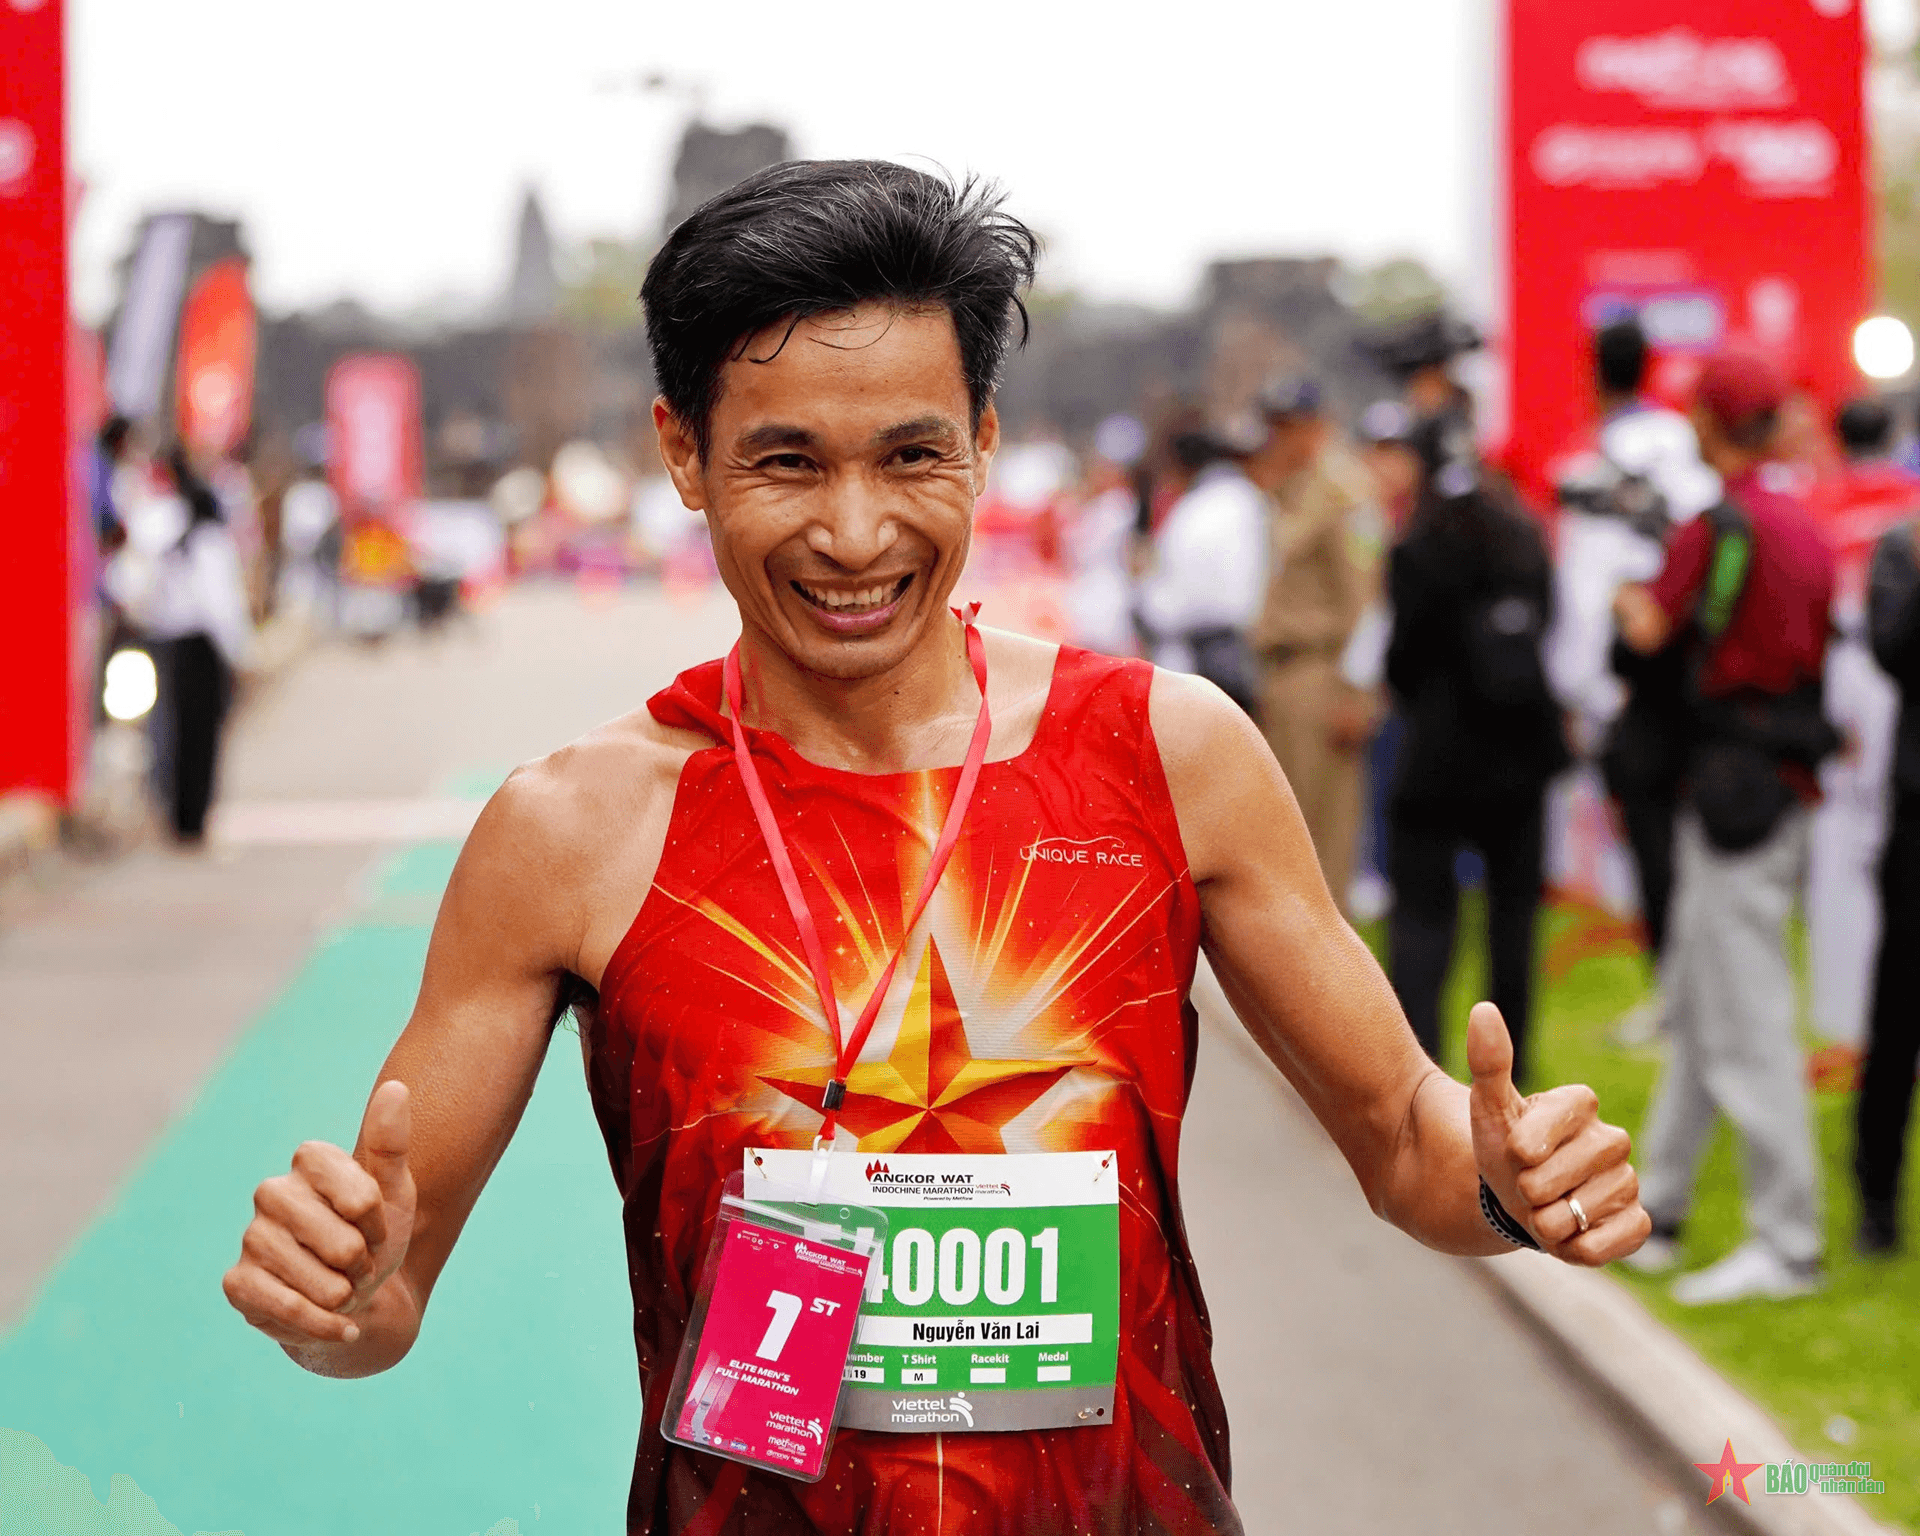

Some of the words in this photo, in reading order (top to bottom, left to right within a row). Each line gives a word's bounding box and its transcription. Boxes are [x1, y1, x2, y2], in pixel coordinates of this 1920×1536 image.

[1020, 847, 1089, 864] UNIQUE
[1096, 851, 1143, 867] RACE
[873, 1173, 935, 1184] ANGKOR
[941, 1174, 974, 1184] WAT
[872, 1185, 921, 1194] INDOCHINE
[922, 1186, 974, 1195] MARATHON
[912, 1319, 975, 1343] Nguyễn
[980, 1321, 1011, 1340] Văn
[1016, 1321, 1040, 1339] Lai
[911, 1353, 937, 1365] Shirt
[970, 1353, 1010, 1364] Racekit
[1038, 1350, 1069, 1362] Medal
[728, 1358, 758, 1373] ELITE
[757, 1366, 791, 1383] MEN'S
[914, 1372, 924, 1382] M
[714, 1366, 740, 1381] FULL
[740, 1373, 800, 1396] MARATHON
[891, 1398, 947, 1411] viettel
[769, 1410, 806, 1428] viettel
[891, 1411, 960, 1424] marathon
[765, 1419, 814, 1439] marathon
